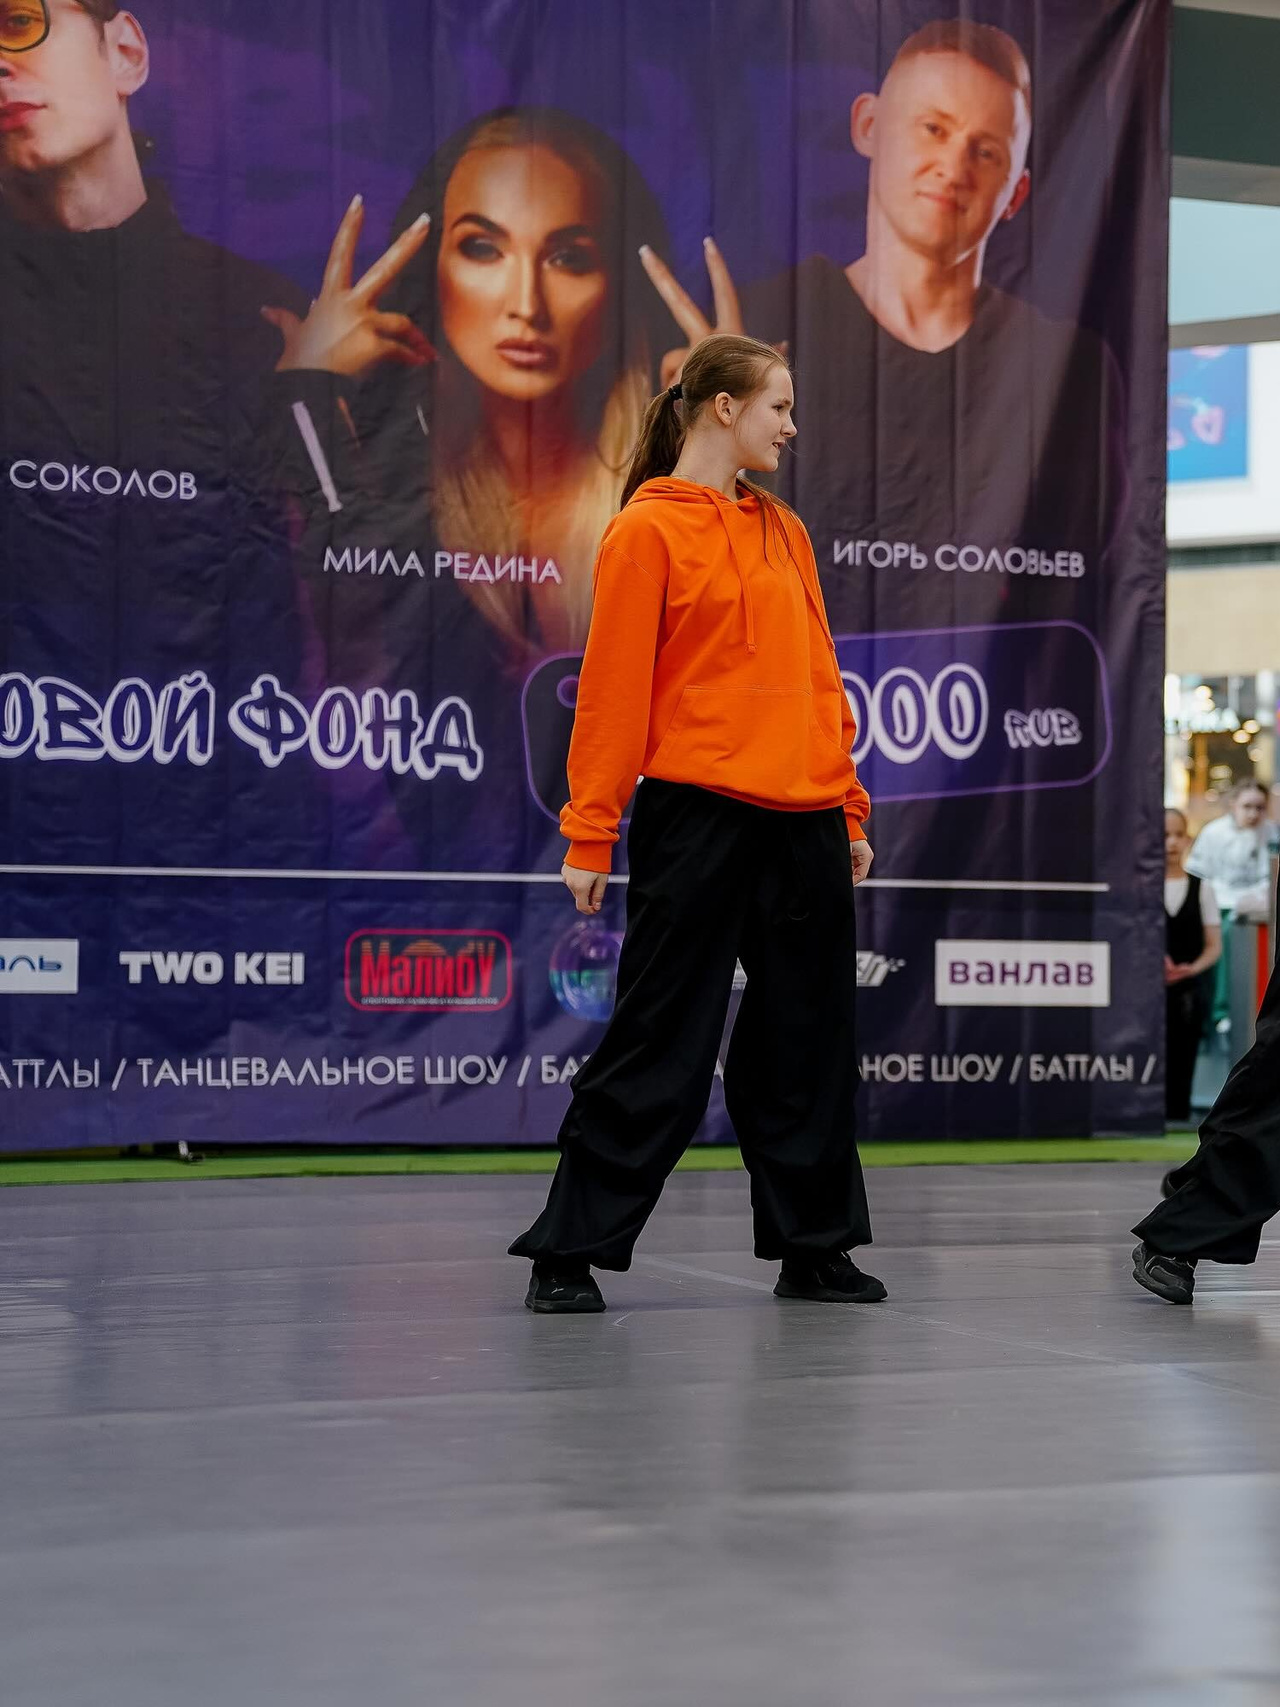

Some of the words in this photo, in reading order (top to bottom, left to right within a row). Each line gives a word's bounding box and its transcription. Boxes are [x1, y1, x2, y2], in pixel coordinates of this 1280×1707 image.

[9, 459, 198, 500] СОКОЛОВ
[323, 546, 425, 578] МИЛА
[435, 551, 562, 584] РЕДИНА
[833, 540, 927, 570] ИГОРЬ
[935, 543, 1085, 578] СОЛОВЬЕВ
[1003, 708, 1082, 749] RUB
[119, 951, 224, 985] TWO
[234, 952, 305, 985] KEI
[948, 955, 1095, 987] ванлав
[137, 1055, 415, 1089] ТАНЦЕВАЛЬНОЕ
[424, 1054, 508, 1086] ШОУ
[930, 1053, 1003, 1083] ШОУ
[1029, 1053, 1134, 1083] БАТТЛЫ
